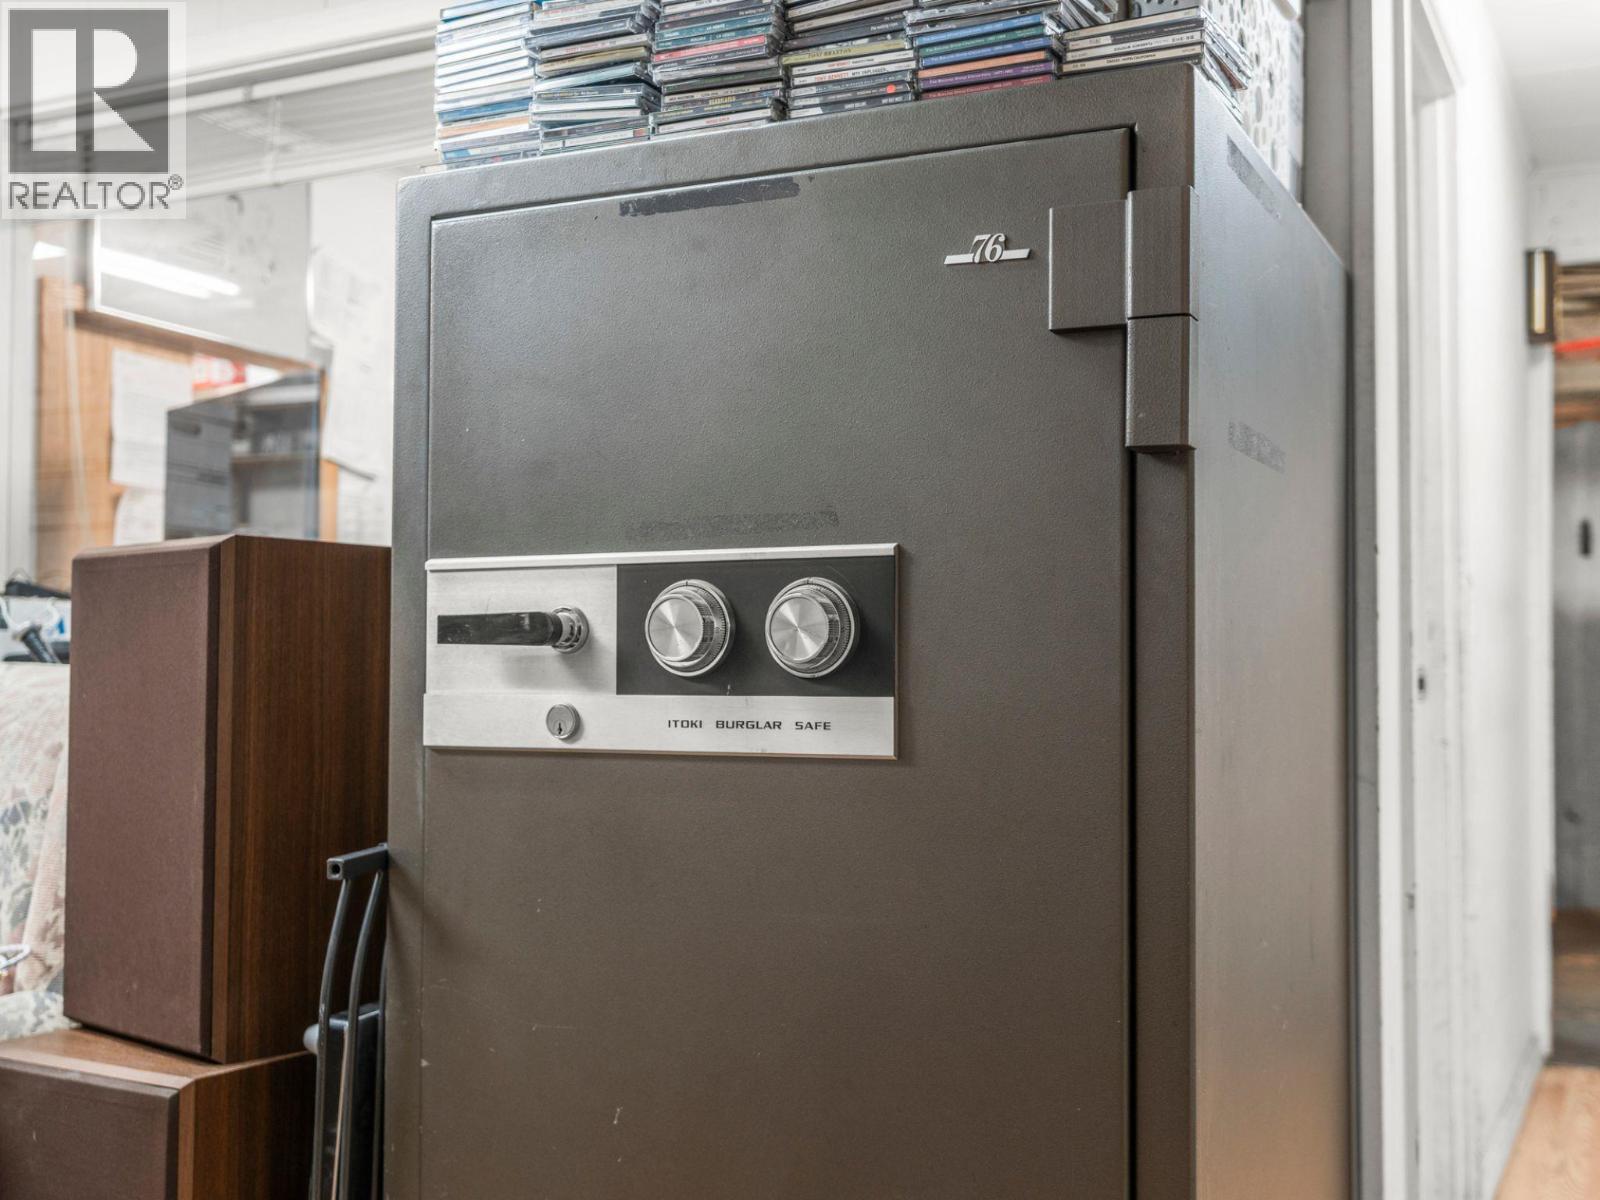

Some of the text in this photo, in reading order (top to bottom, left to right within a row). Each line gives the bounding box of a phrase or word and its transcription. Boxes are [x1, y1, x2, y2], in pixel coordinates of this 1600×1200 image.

[970, 233, 1006, 263] 76
[668, 719, 832, 731] ITOKI BURGLAR SAFE
